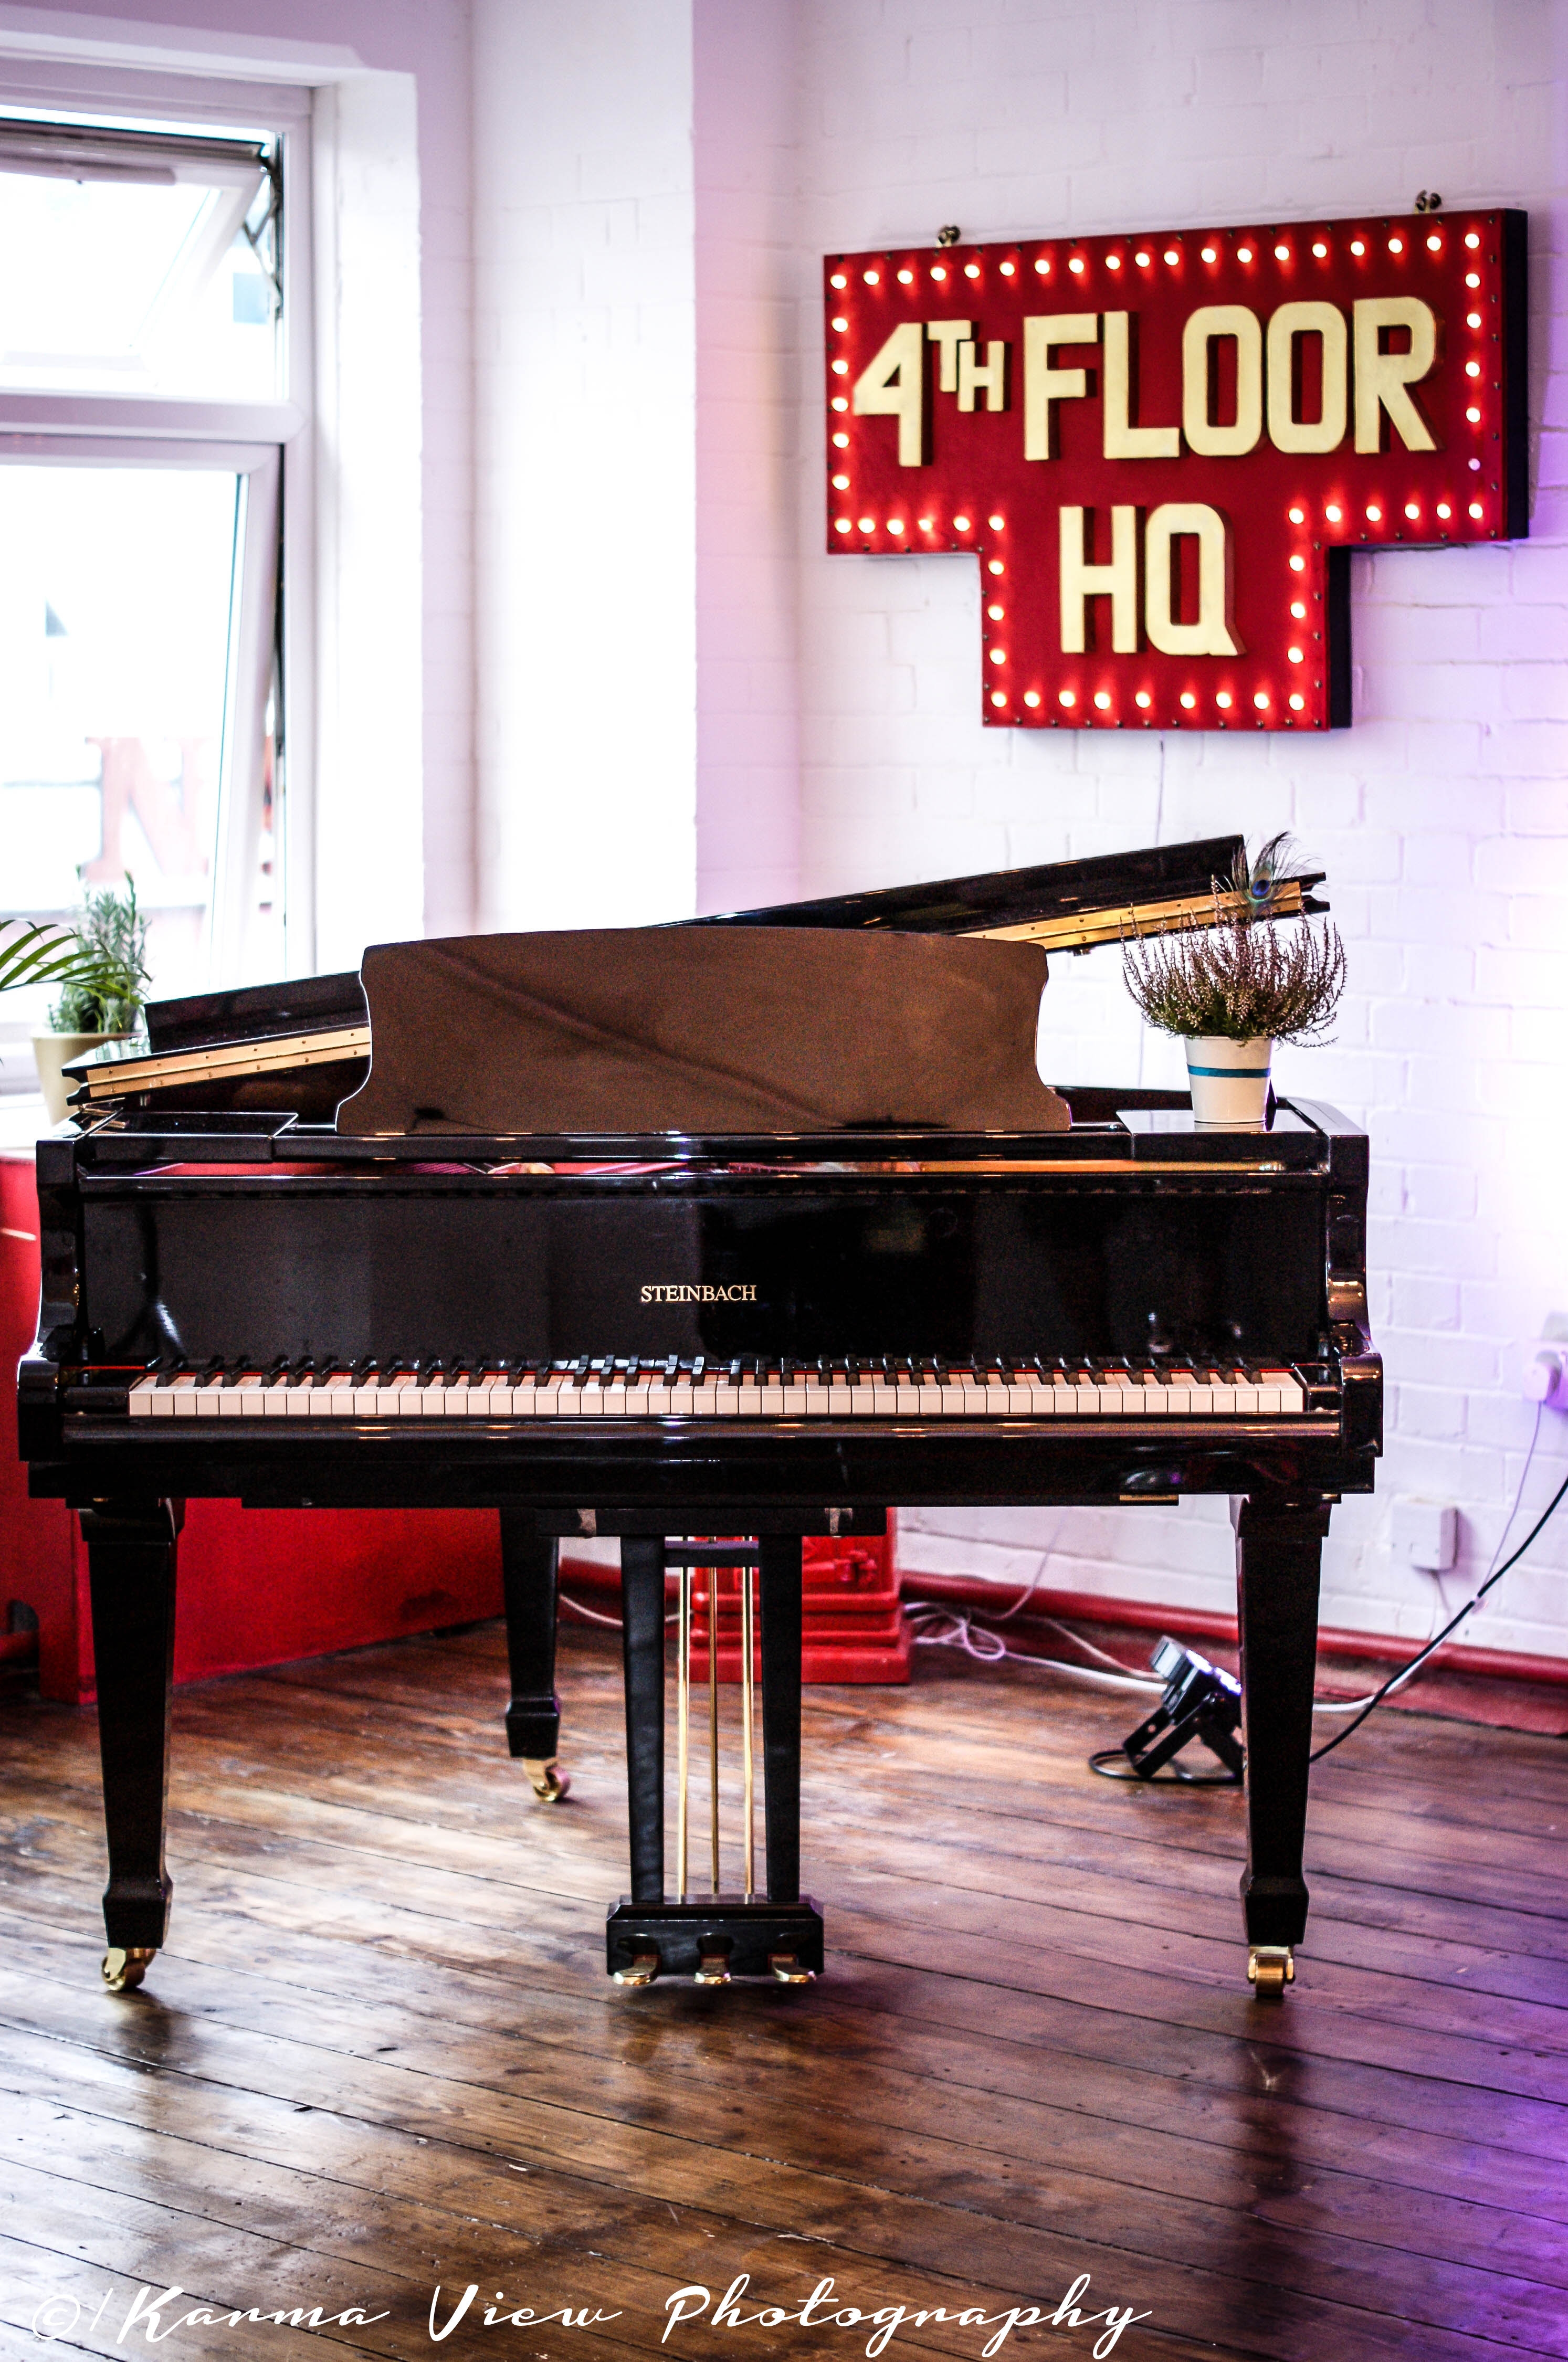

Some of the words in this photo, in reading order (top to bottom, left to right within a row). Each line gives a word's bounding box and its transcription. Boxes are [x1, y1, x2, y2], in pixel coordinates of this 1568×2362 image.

[852, 319, 1004, 467] 4TH
[1024, 297, 1437, 461] FLOOR
[1059, 503, 1240, 656] HQ
[640, 1285, 757, 1303] STEINBACH
